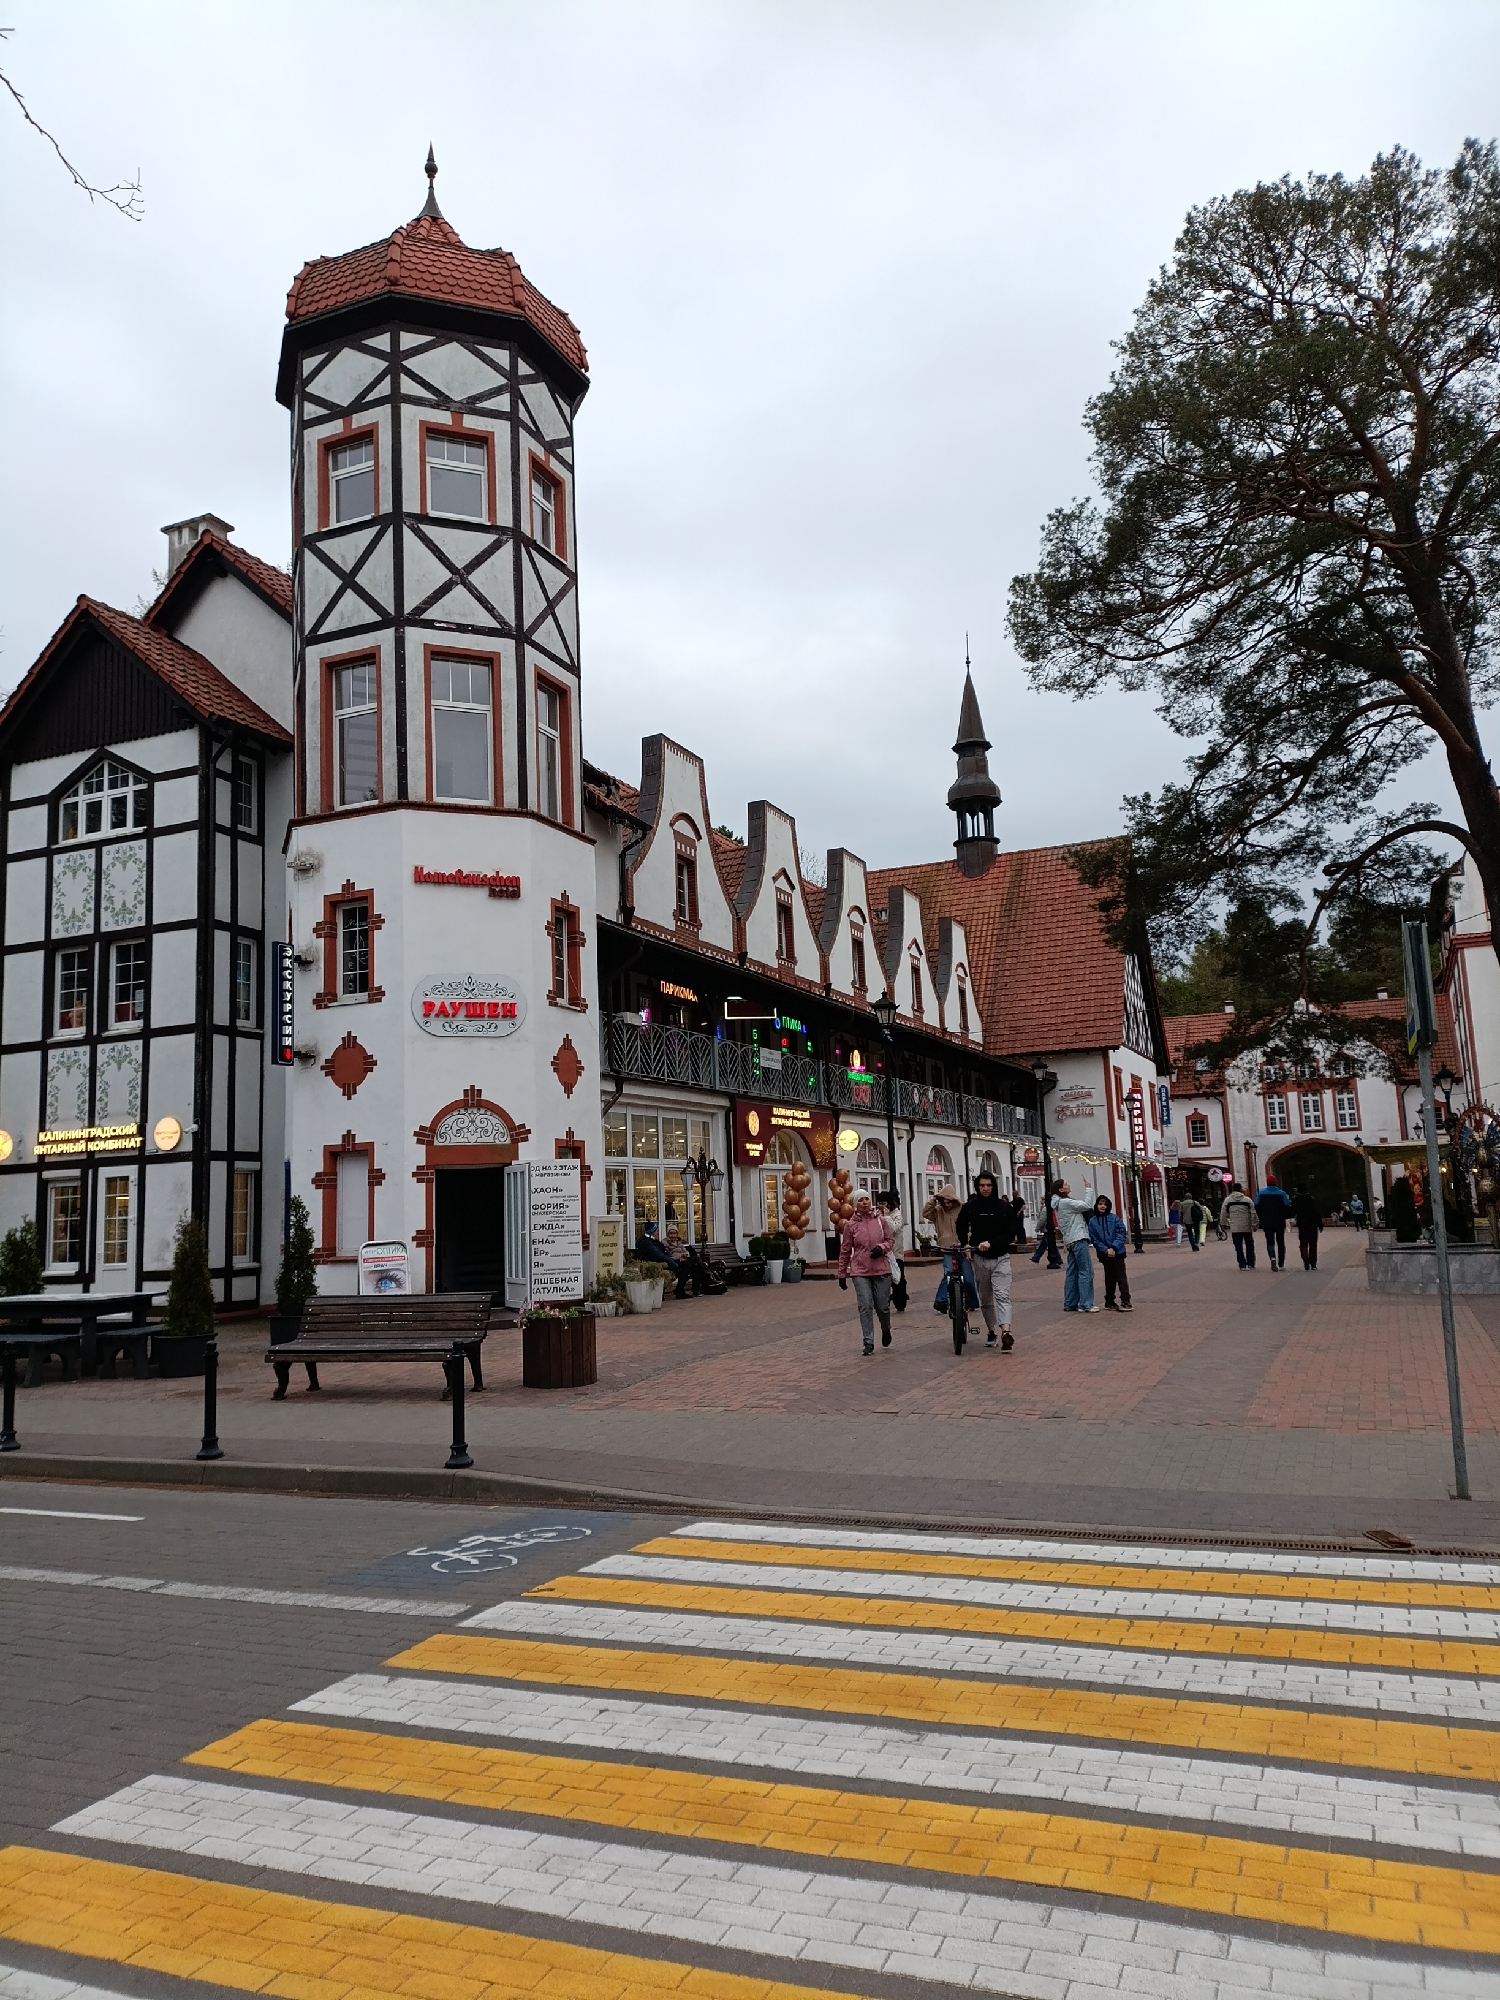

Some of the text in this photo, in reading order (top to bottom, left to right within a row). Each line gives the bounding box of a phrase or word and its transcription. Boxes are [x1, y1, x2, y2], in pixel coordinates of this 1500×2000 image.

[414, 866, 521, 886] HomeRauschen
[282, 947, 292, 1046] ЭКСКУРСИИ
[423, 1000, 517, 1018] РАУШЕН
[39, 1123, 138, 1142] КАЛИНИНГРАДСКИЙ
[33, 1137, 143, 1155] ЯНТАРНЫЙ КОМБИНАТ
[532, 1223, 565, 1231] ЕЖДА»
